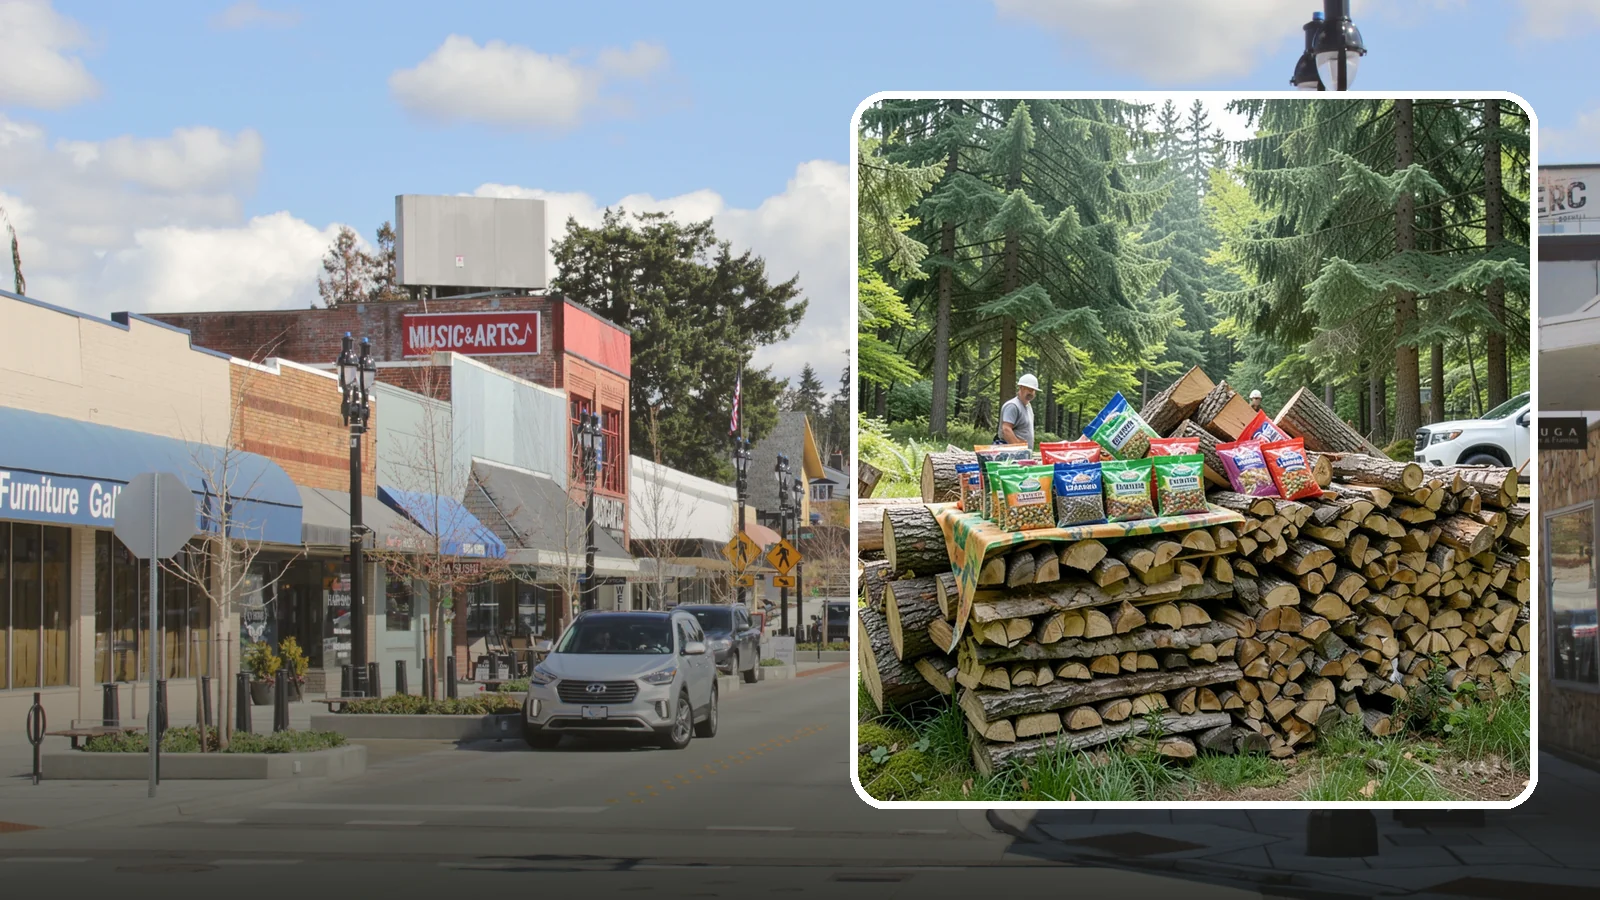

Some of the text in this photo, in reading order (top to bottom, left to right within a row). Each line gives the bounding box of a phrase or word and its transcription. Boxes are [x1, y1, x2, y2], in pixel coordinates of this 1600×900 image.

[408, 322, 520, 349] MUSIC&ARTS
[1540, 427, 1577, 436] UGA
[0, 471, 122, 519] Furniture Gal
[453, 563, 479, 574] SUSHI
